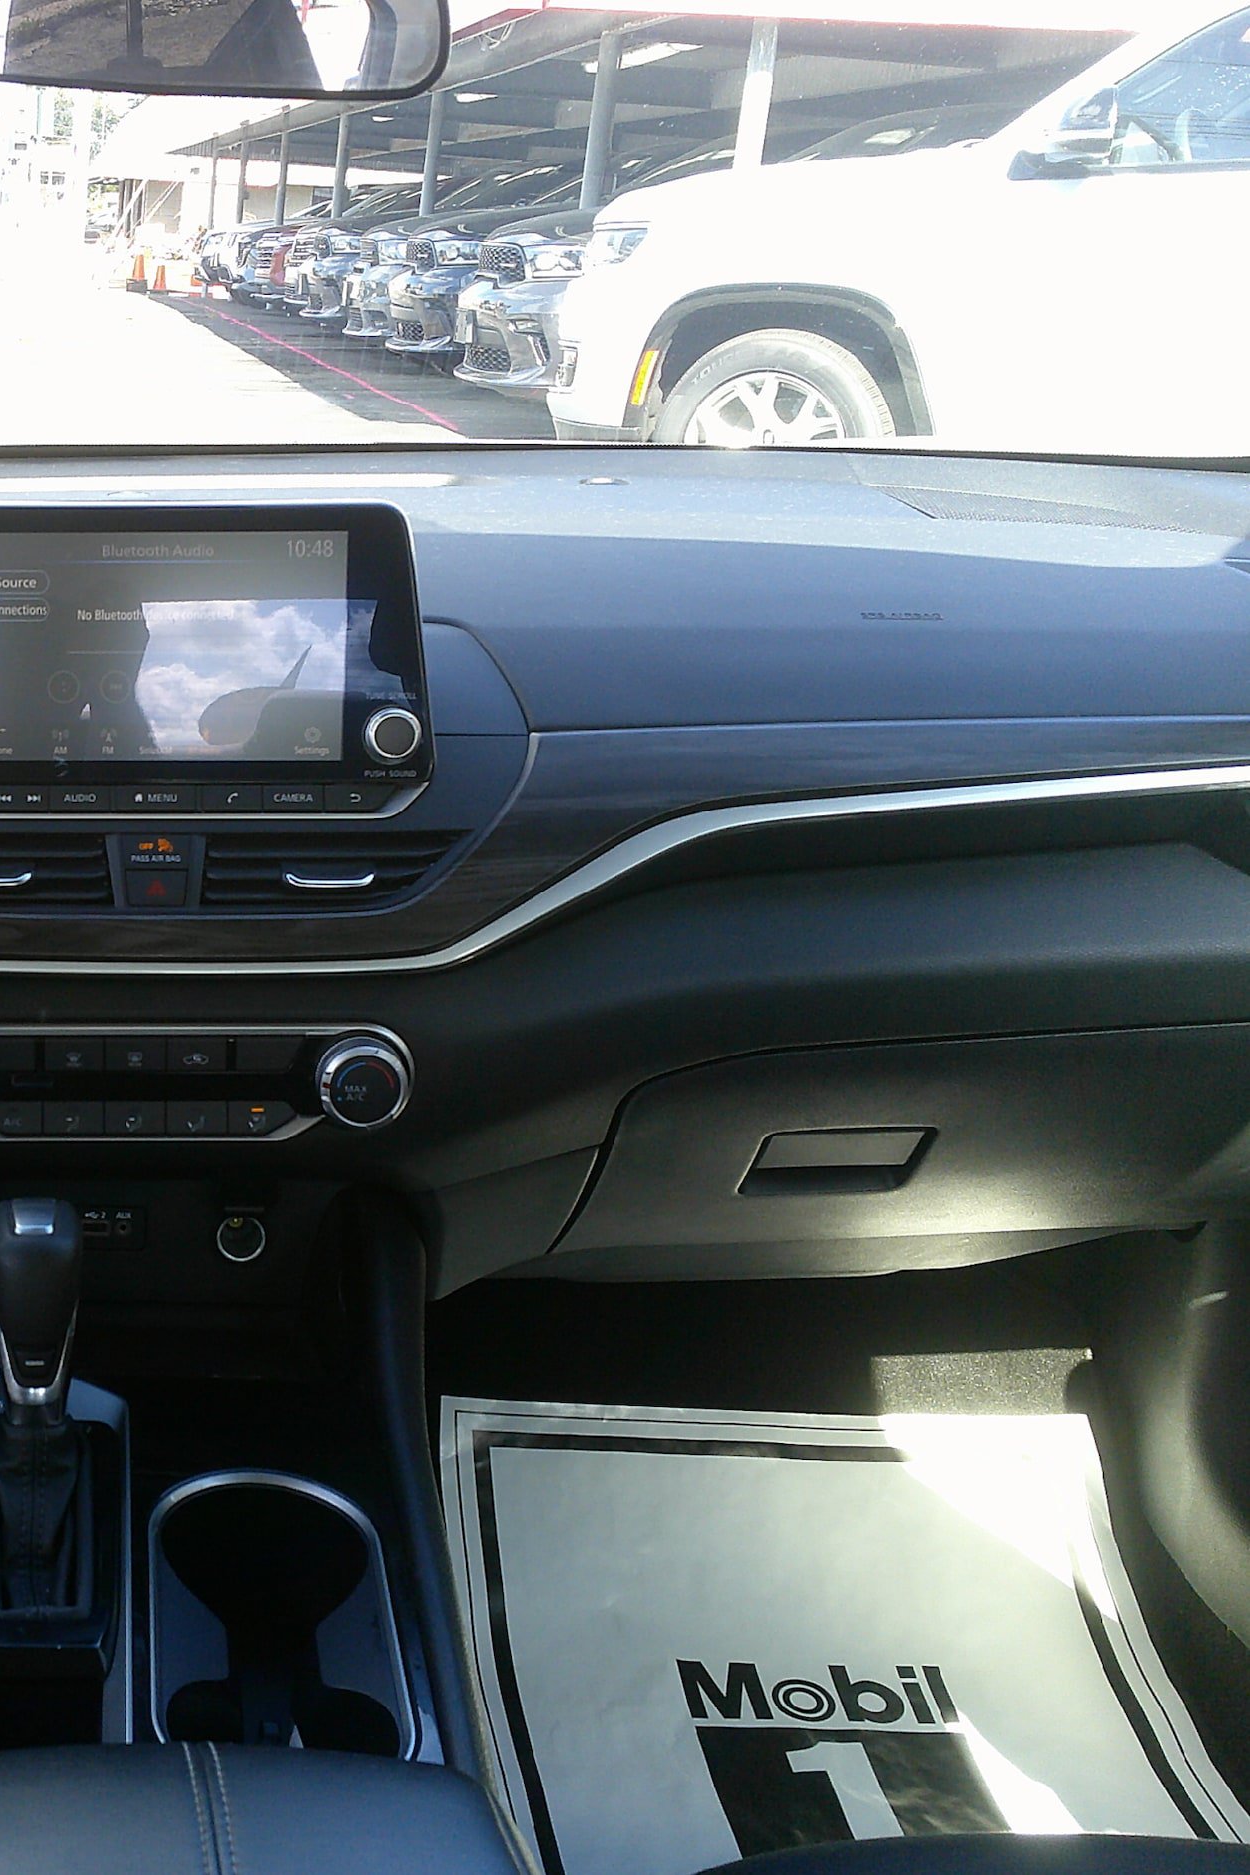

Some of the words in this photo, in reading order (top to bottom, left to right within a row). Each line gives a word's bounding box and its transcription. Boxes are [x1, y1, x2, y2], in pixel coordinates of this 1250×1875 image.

[102, 545, 169, 557] Bluetooth
[172, 544, 214, 557] Audio
[287, 540, 334, 558] 10:48
[77, 608, 92, 621] No
[94, 608, 142, 621] Bluetooth
[54, 746, 68, 755] AM
[102, 746, 114, 754] FM
[295, 746, 330, 757] Settings
[364, 770, 386, 778] PUSH
[64, 794, 97, 803] AUDIO
[148, 794, 178, 802] MENU
[273, 793, 313, 802] CAMERA
[131, 854, 150, 862] PASS
[151, 854, 164, 862] AIR
[165, 854, 181, 862] BAG
[345, 1085, 367, 1093] MAX
[676, 1659, 961, 1725] Mobil
